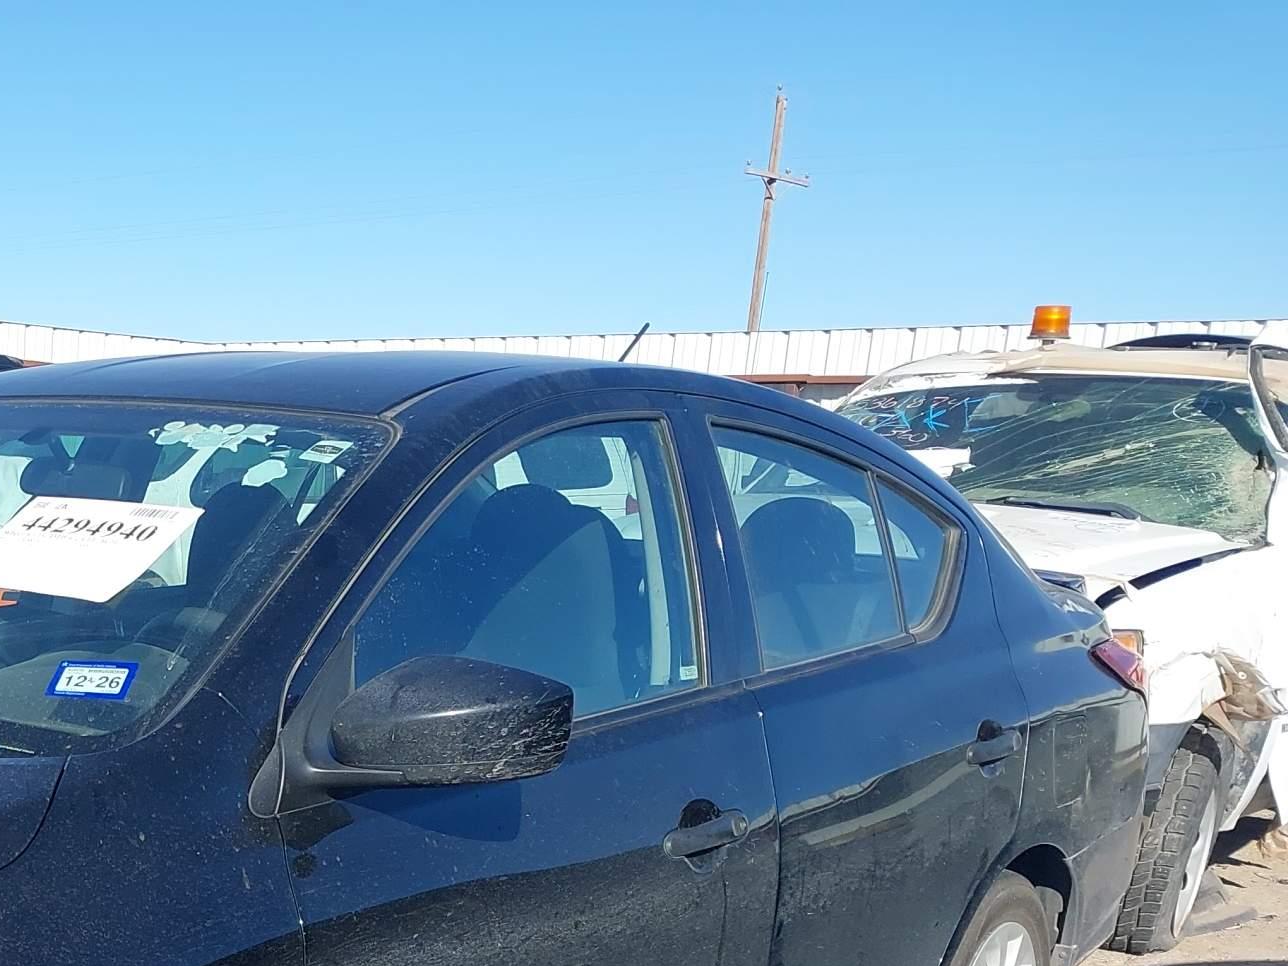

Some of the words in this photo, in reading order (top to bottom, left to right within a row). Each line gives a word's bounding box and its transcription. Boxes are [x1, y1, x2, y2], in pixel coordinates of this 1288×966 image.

[23, 515, 158, 541] 44294940
[65, 675, 87, 687] 12
[95, 676, 121, 689] 26
